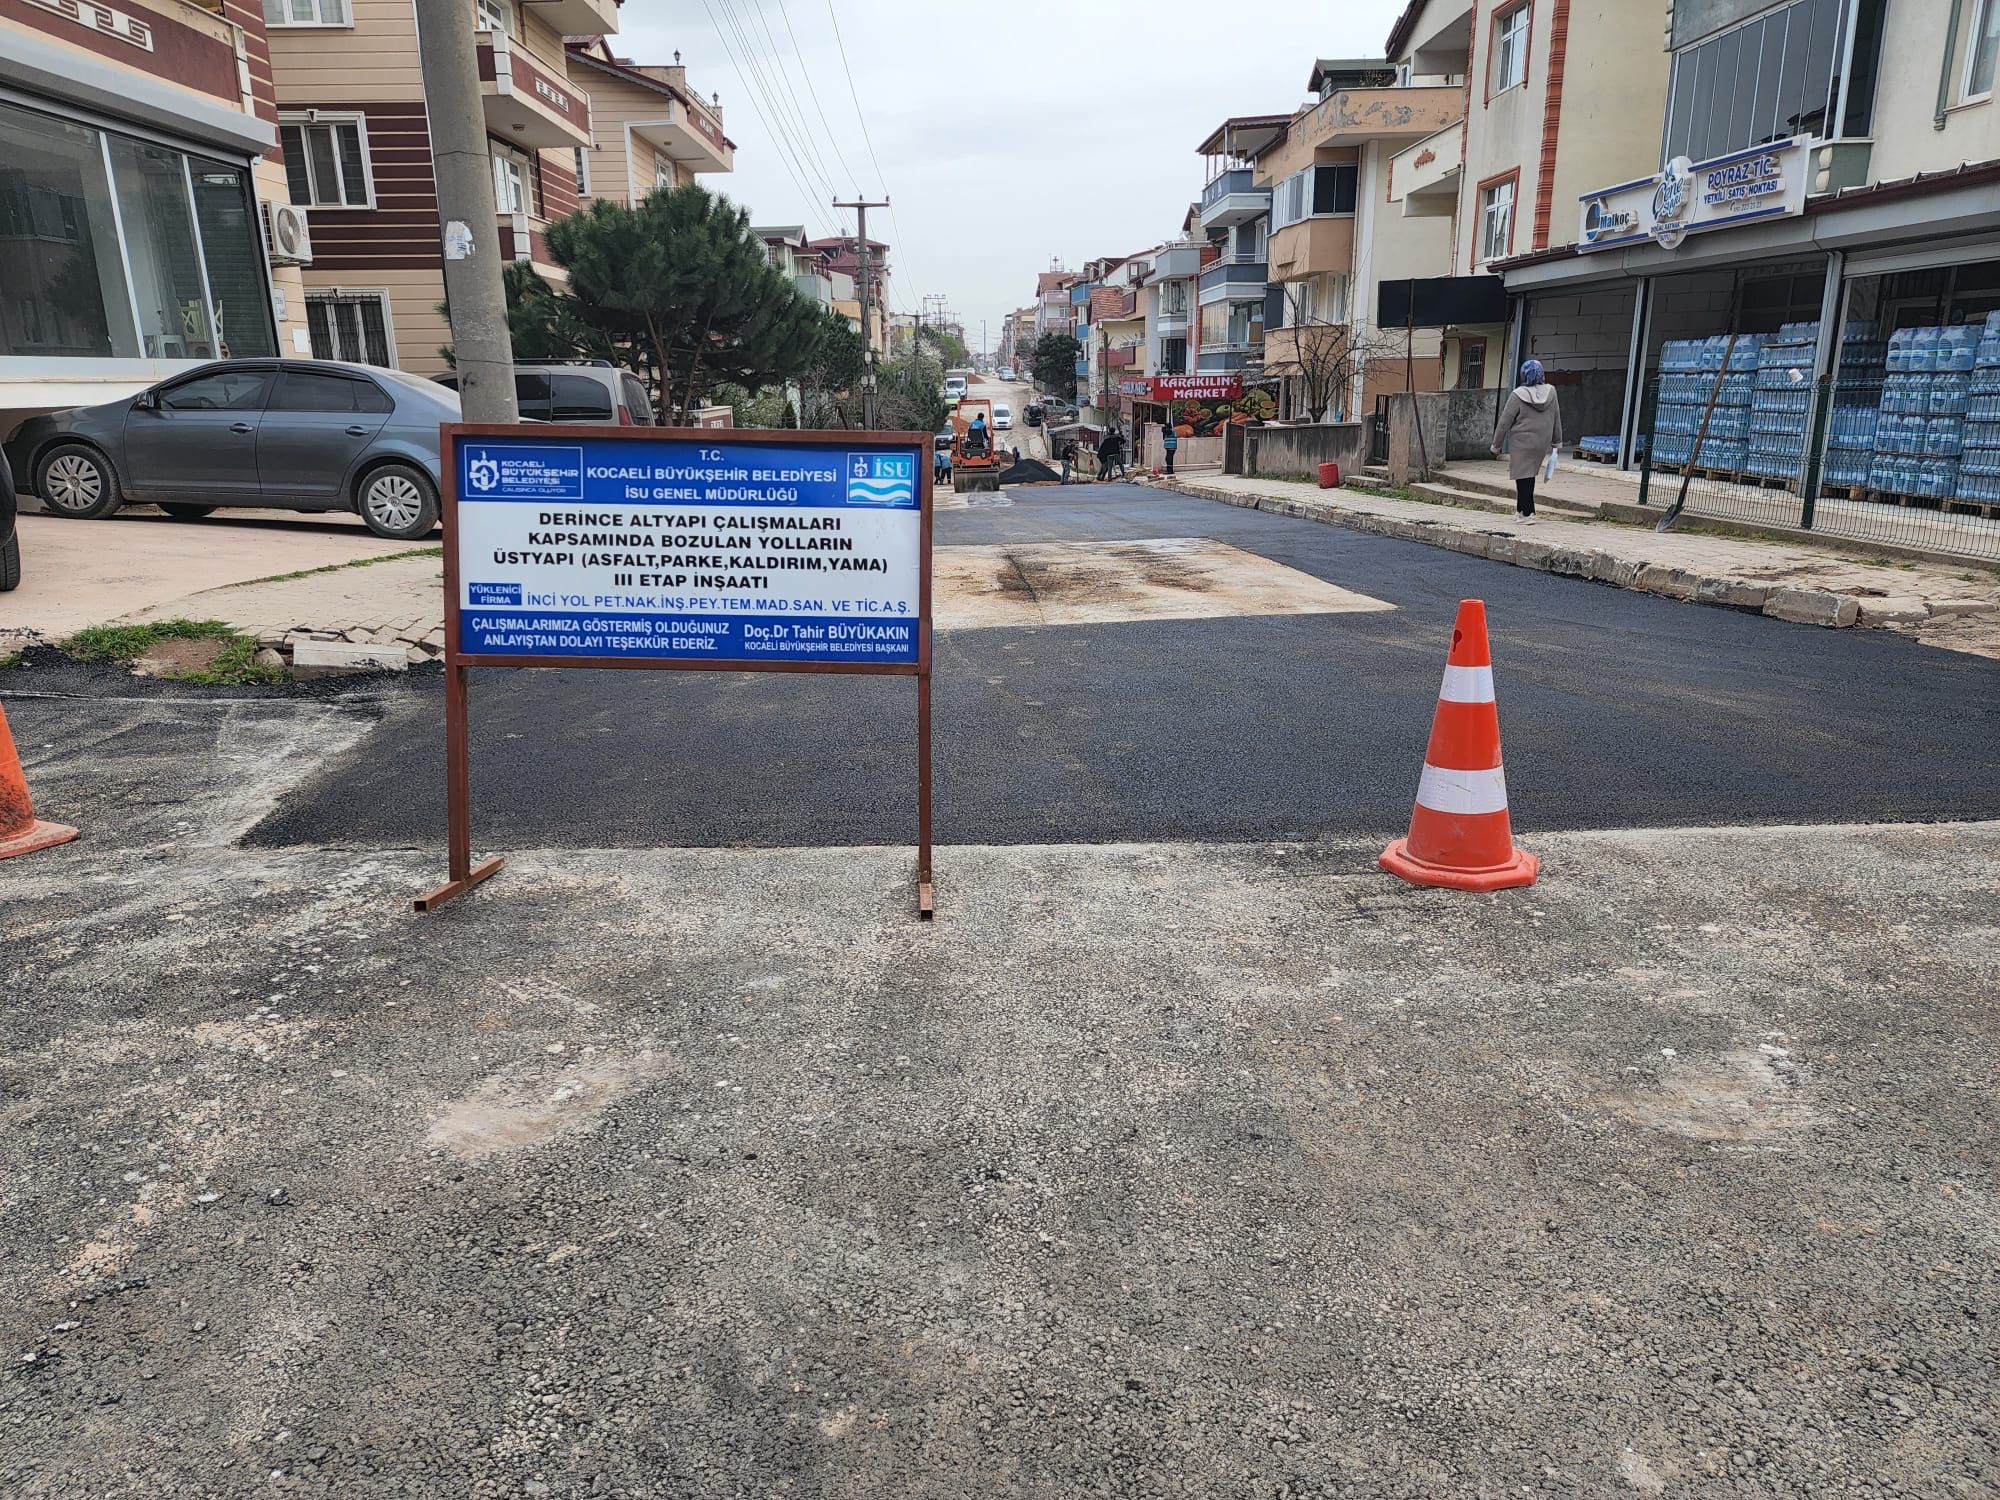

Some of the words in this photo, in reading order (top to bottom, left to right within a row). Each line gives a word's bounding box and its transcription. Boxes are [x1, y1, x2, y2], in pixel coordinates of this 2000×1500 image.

[1708, 163, 1749, 188] POYRAZ
[1753, 156, 1773, 177] TİC.
[1748, 180, 1778, 195] NOKTASI
[1600, 212, 1630, 229] Malkoç
[1173, 388, 1228, 398] MARKET
[501, 460, 545, 468] KOCAELİ
[699, 450, 725, 461] T.C.
[587, 466, 651, 480] KOCAELİ
[655, 467, 748, 483] BÜYÜKŞEHİR
[752, 468, 837, 483] BELEDİYESİ
[874, 458, 911, 478] İSU
[625, 485, 649, 499] İSU
[653, 487, 702, 500] GENEL
[705, 486, 798, 502] MÜDÜRLÜĞÜ
[539, 510, 624, 527] DERİNCE
[629, 514, 706, 528] ALTYAPI
[713, 515, 841, 533] ÇALIŞMALARI
[528, 532, 655, 547] KAPSAMINDA
[661, 535, 751, 548] BOZULAN
[758, 536, 853, 551] YOLLARIN
[493, 548, 574, 566] ÜSTYAPI
[581, 553, 888, 574] (ASFALT,PARKE,KALDIRIM,YAMA)
[470, 584, 522, 595] YÜKLENİCİ
[614, 573, 632, 586] III
[639, 574, 687, 587] ETAP
[693, 572, 768, 591] İNŞAATI
[480, 594, 511, 604] FİRMA
[527, 592, 556, 606] İNCİ
[560, 595, 590, 607] YOL
[595, 594, 827, 611] PET.NAK.İNŞ.PEY.TEM.MAD.SAN.
[831, 600, 850, 612] VE
[856, 598, 911, 614] TİC.A.Ş.
[472, 617, 580, 633] ÇALIŞMALARIMIZA
[582, 618, 652, 634] GÖSTERMİŞ
[655, 619, 729, 635] OLDUĞUNUZ
[744, 624, 789, 640] Doç.Dr
[792, 625, 825, 639] Tahir
[828, 623, 909, 640] BÜYÜKAKIN
[484, 634, 558, 648] ANLAYIŞTAN
[559, 635, 602, 648] DOLAYI
[605, 635, 669, 651] TEŞEKKÜR
[672, 636, 718, 650] EDERİZ.
[744, 640, 778, 651] KOCAELİ
[779, 641, 828, 653] BÜYÜKŞEHİR
[830, 642, 874, 653] BELEDİYESİ
[875, 643, 909, 654] BAŞKANI
